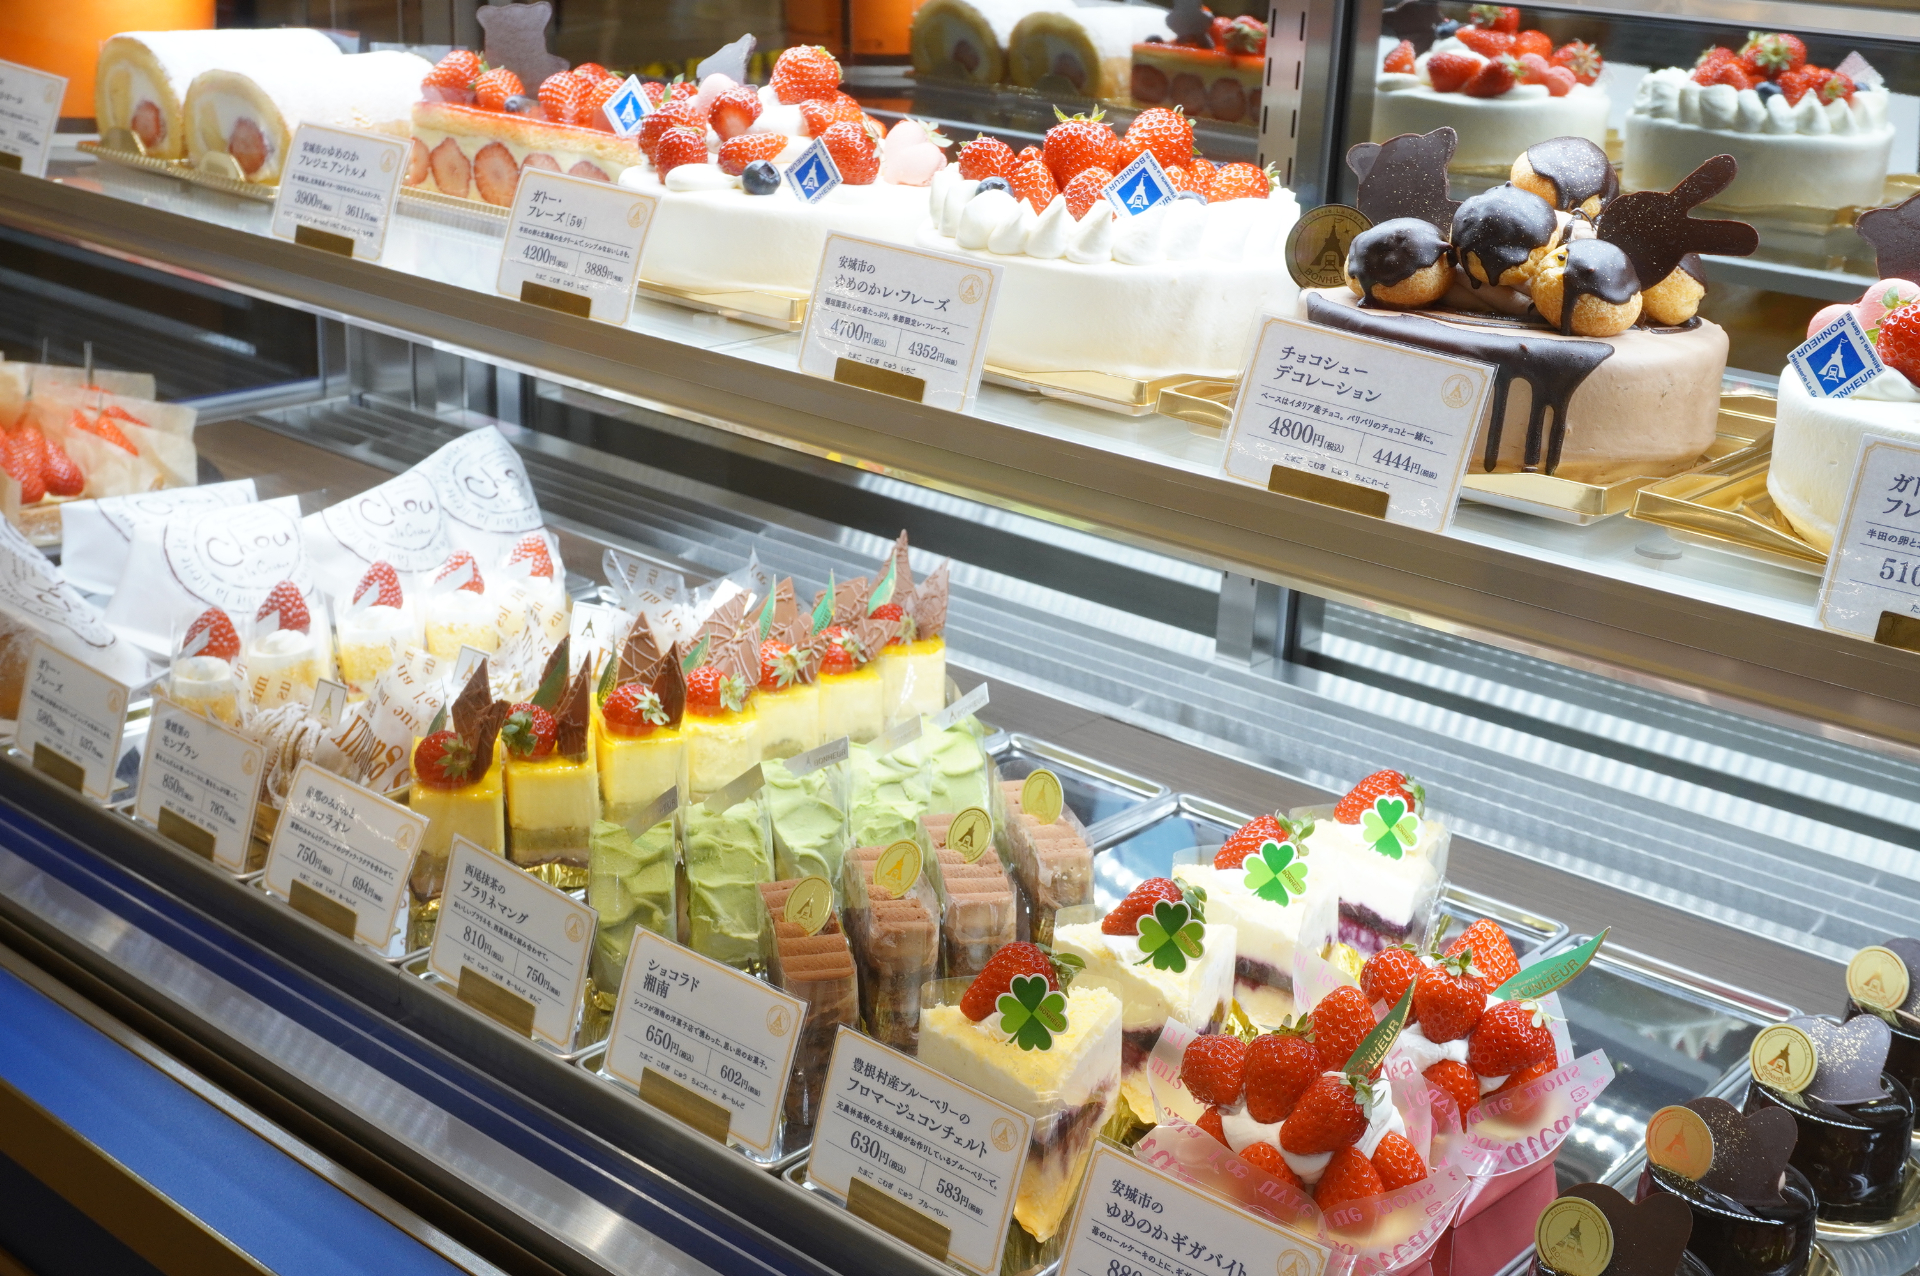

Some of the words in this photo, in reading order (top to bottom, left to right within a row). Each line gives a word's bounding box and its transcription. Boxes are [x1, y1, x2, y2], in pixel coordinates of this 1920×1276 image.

[788, 143, 818, 174] BONHEUR
[1108, 156, 1146, 192] BONHEUR
[810, 179, 837, 205] ONHEUR
[839, 255, 876, 274] 安城市の
[835, 274, 950, 312] ゆめのかレ・フレーズ
[1796, 317, 1846, 357] BONHEUR
[1851, 321, 1861, 336] Gare
[1859, 335, 1865, 344] La
[848, 352, 862, 360] たまご
[865, 356, 879, 365] こむぎ
[883, 361, 897, 370] にゅう
[900, 366, 916, 374] いちご
[1280, 346, 1368, 375] チョコシュー
[1273, 365, 1382, 402] デコレーション
[1832, 368, 1876, 398] ONHEUR
[1268, 416, 1344, 453] 4800円(税込)
[1308, 460, 1326, 471] こむぎ
[1331, 467, 1349, 476] にゅう
[1355, 474, 1390, 489] ちょこれーと
[359, 489, 434, 528] Chou
[206, 528, 291, 568] Chou
[465, 863, 506, 894] 西尾抹茶の
[461, 880, 529, 924] プラリネマング
[463, 953, 475, 964] たまご
[477, 962, 488, 972] にゅう
[492, 971, 503, 981] こむぎ
[648, 959, 700, 992] ショコラド
[1510, 959, 1580, 1000] BONHEUR
[643, 973, 670, 999] 湘南
[646, 1024, 694, 1063] 650円(税込)
[639, 1051, 653, 1062] たまご
[656, 1060, 670, 1071] こむぎ
[673, 1069, 687, 1080] にゅう
[691, 1077, 717, 1096] ちょこれーと
[721, 1093, 745, 1109] あーもんど
[852, 1057, 970, 1124] 豊根村産ブルーベリーの
[1762, 1064, 1792, 1083] BONHEUR
[847, 1077, 987, 1158] フロマージュコンチェルト
[850, 1130, 906, 1174] 630円(税込)
[857, 1166, 874, 1179] たまご
[877, 1177, 894, 1190] こむぎ
[897, 1188, 913, 1200] にゅう
[918, 1198, 948, 1218] ブルーベリー
[1110, 1179, 1163, 1214] 安城市の
